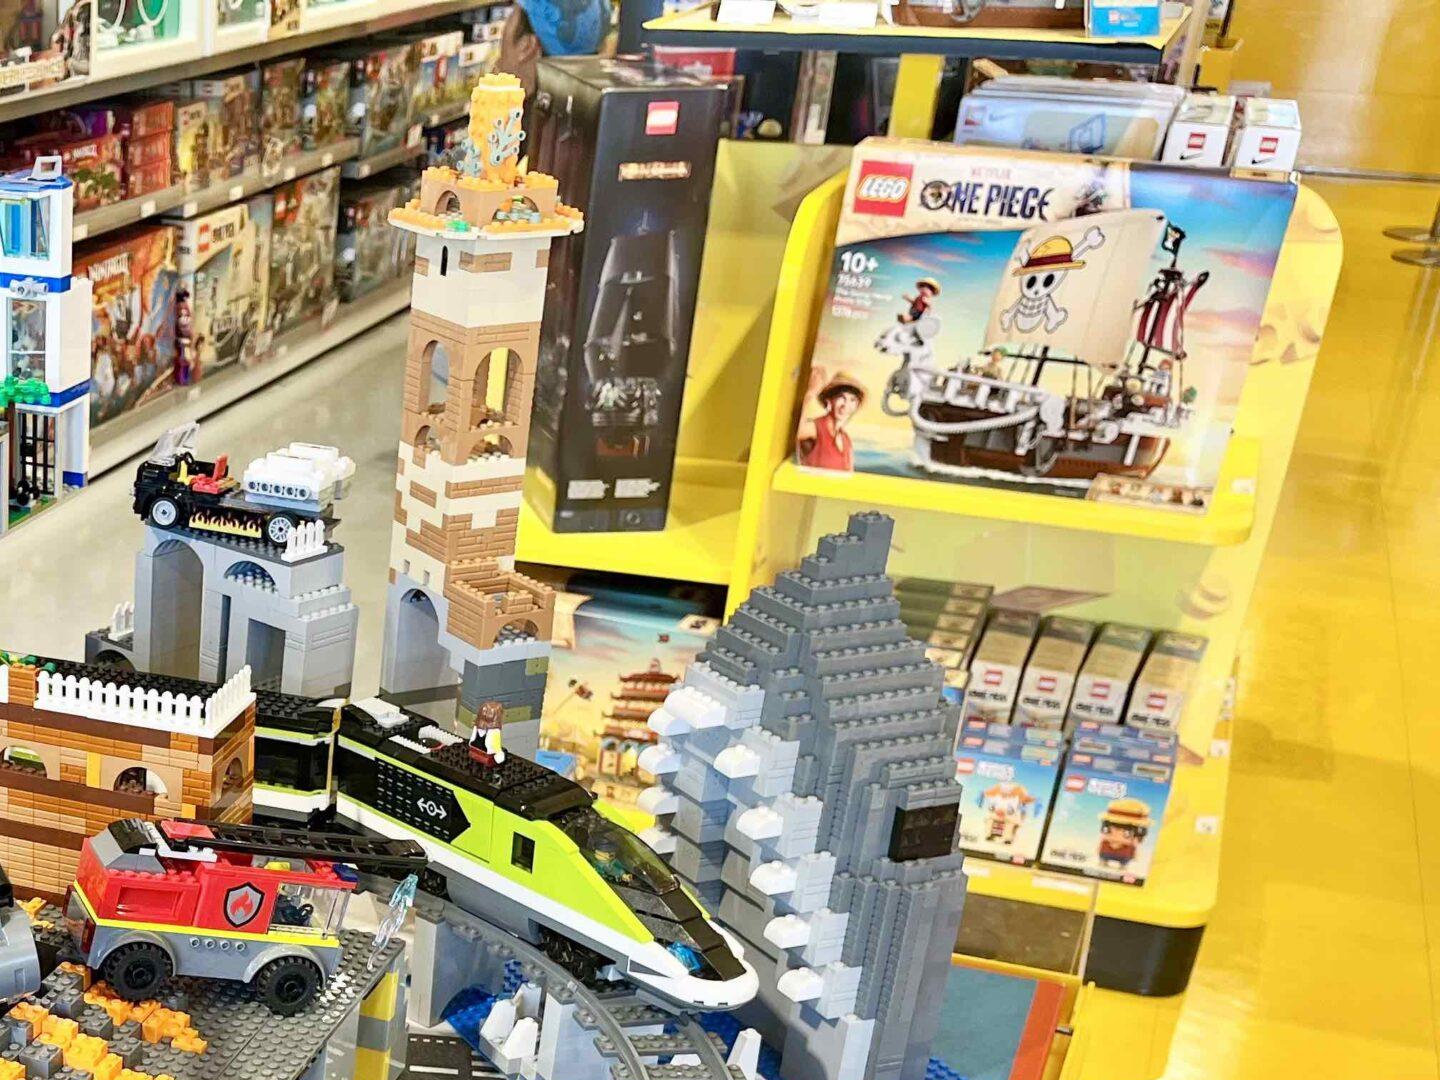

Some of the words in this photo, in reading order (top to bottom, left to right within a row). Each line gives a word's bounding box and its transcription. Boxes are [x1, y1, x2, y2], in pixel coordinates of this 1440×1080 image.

[860, 175, 908, 201] LEGO
[984, 182, 1055, 221] PIECE
[841, 251, 879, 273] 10+
